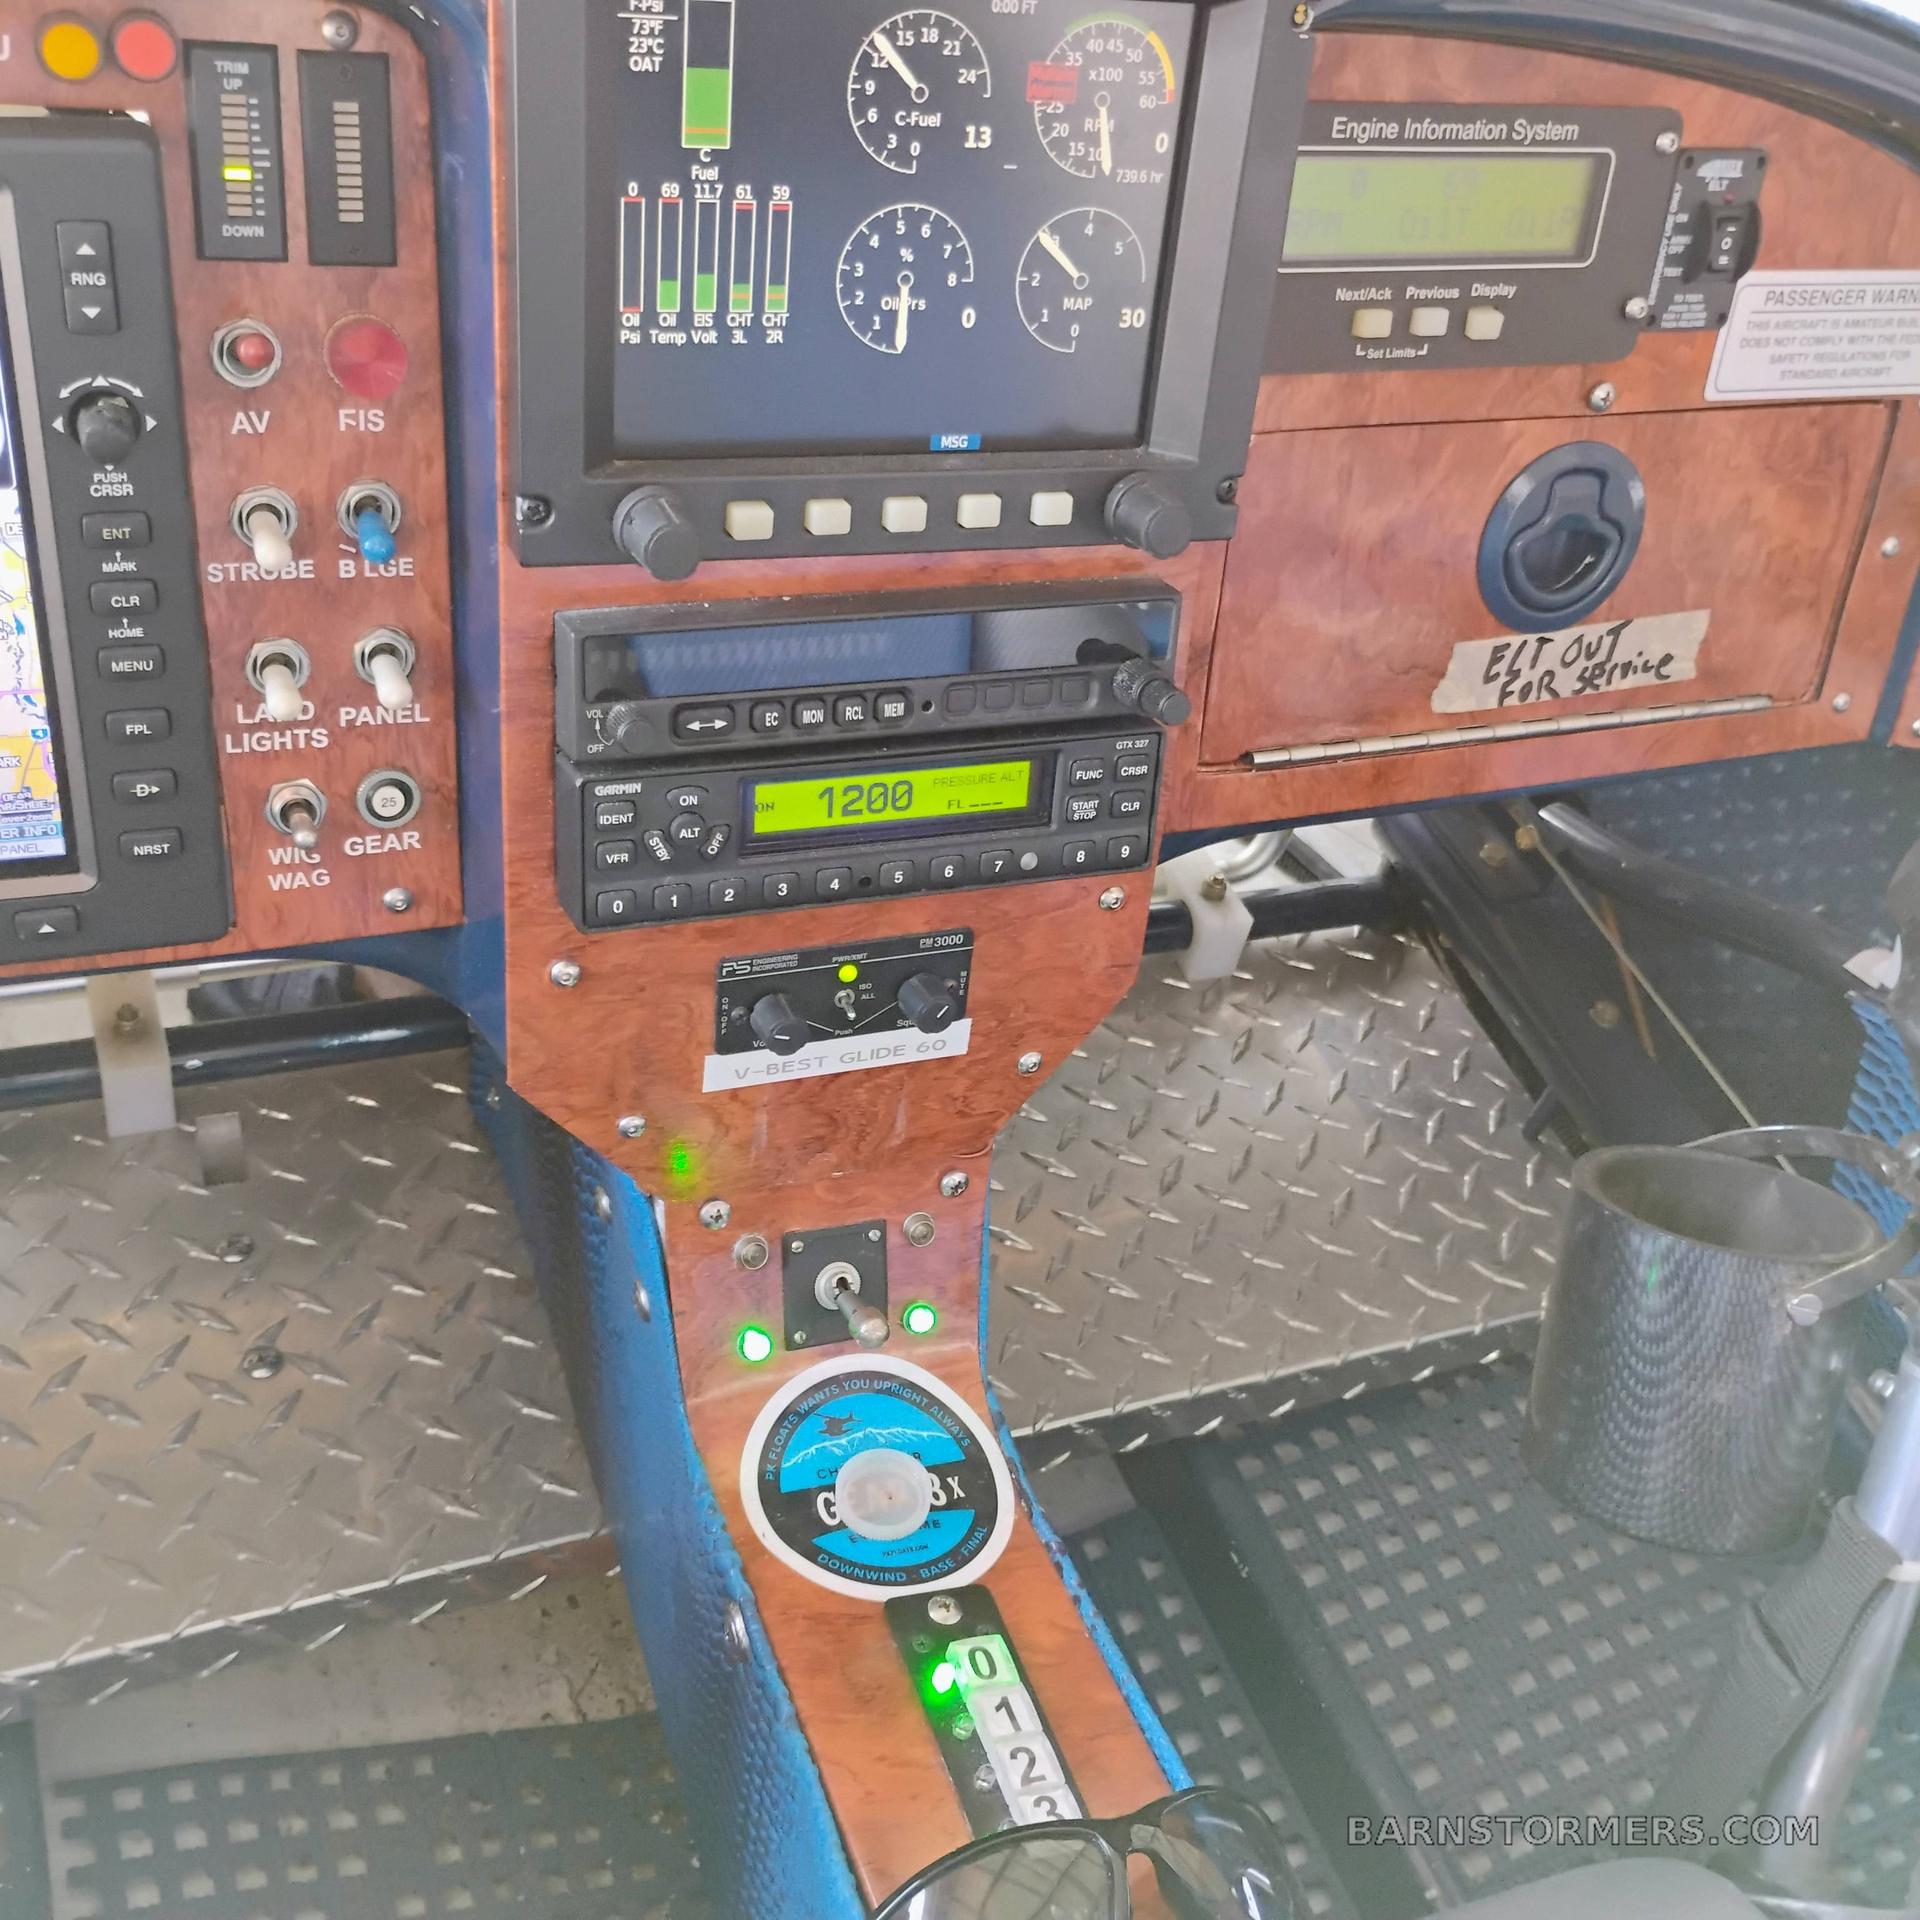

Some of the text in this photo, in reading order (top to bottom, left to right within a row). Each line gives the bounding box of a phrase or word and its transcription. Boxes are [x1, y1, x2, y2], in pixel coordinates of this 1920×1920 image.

[896, 31, 915, 46] 15
[920, 28, 939, 43] 18
[943, 41, 961, 56] 21
[1086, 39, 1104, 52] 40
[1106, 39, 1124, 53] 45
[1065, 52, 1082, 66] 35
[1126, 49, 1143, 63] 50
[214, 61, 249, 75] TRIM
[629, 56, 663, 72] OAT
[958, 69, 977, 84] 24
[1089, 68, 1123, 82] x100
[1139, 72, 1155, 85] 55
[223, 78, 242, 90] UP
[865, 80, 875, 95] 9
[867, 108, 878, 123] 6
[895, 111, 942, 127] C-Fuel
[964, 125, 992, 149] 13
[1051, 124, 1069, 137] 20
[1331, 117, 1579, 145] Engine Information System
[887, 134, 897, 149] 3
[1155, 132, 1169, 153] 0
[699, 148, 711, 162] C
[910, 142, 920, 156] 0
[1069, 142, 1085, 157] 15
[691, 165, 719, 181] Fuel
[1116, 170, 1147, 184] 739.6
[628, 182, 638, 197] 0
[661, 183, 680, 197] 69
[694, 184, 724, 199] 11.7
[735, 184, 753, 199] 61
[772, 185, 791, 200] 59
[222, 224, 265, 238] DOWN
[896, 220, 905, 235] 5
[921, 224, 931, 238] 6
[1084, 223, 1093, 236] 4
[869, 234, 879, 248] 4
[900, 248, 914, 262] %
[943, 244, 953, 259] 7
[1114, 242, 1123, 255] 5
[854, 263, 864, 277] 3
[71, 273, 106, 287] RNG
[947, 272, 957, 287] 8
[1031, 273, 1040, 287] 2
[854, 291, 864, 305] 2
[1335, 283, 1517, 302] Next/Ack Previous Display
[1764, 290, 1865, 306] PASSENGER
[1063, 297, 1093, 310] MAP
[622, 313, 640, 327] Oil
[659, 313, 677, 327] Oil
[694, 313, 714, 327] EIS
[726, 313, 754, 327] CHT
[762, 313, 789, 327] CHT
[872, 315, 880, 330] 1
[961, 307, 976, 329] 0
[1119, 309, 1145, 328] 30
[620, 331, 640, 344] Psi
[691, 331, 718, 344] Volt
[732, 331, 748, 344] 3L
[766, 331, 784, 344] 2R
[1070, 324, 1079, 337] 0
[649, 330, 687, 346] Temp
[1366, 347, 1416, 359] Set Limits
[231, 411, 270, 434] AV
[338, 408, 386, 433] FIS
[940, 435, 968, 449] MSG
[93, 472, 127, 484] PUSH
[90, 484, 134, 497] CRSR
[102, 527, 131, 541] ENT
[102, 560, 137, 573] MARK
[111, 595, 140, 608] CLR
[108, 627, 144, 639] HOME
[1483, 619, 1633, 684] ELT OUT
[111, 659, 153, 673] MENU
[1497, 670, 1560, 707] FOR
[237, 701, 315, 724] LAD
[339, 703, 430, 727] PANEL
[586, 709, 604, 719] VOL
[803, 709, 824, 724] MON
[845, 707, 864, 721] RCL
[884, 703, 905, 717] MEM
[765, 713, 778, 726] EC
[126, 724, 152, 736] FPL
[225, 728, 330, 754] LIGHTS
[1115, 739, 1149, 750] GTX 327
[587, 744, 605, 753] OFF
[1076, 769, 1103, 780] FUNC
[1120, 765, 1148, 777] CRSR
[933, 770, 1024, 788] PRESSURE ALT
[595, 783, 642, 796] GARMIN
[381, 796, 397, 809] 25
[679, 795, 698, 806] ON
[818, 780, 913, 818] 1200
[1072, 800, 1099, 810] START
[755, 803, 774, 814] ON
[1121, 802, 1140, 812] CLR
[600, 813, 634, 825] IDENT
[1073, 811, 1096, 821] STOP
[679, 828, 700, 839] ALT
[134, 843, 170, 856] NRST
[344, 831, 422, 856] GEAR
[649, 837, 671, 862] STBY
[708, 832, 725, 855] OFF
[268, 847, 321, 866] WIG
[606, 854, 628, 864] VFR
[1076, 850, 1086, 863] 8
[1121, 846, 1130, 858] 9
[944, 865, 954, 878] 6
[995, 860, 1003, 873] 7
[268, 868, 331, 891] WAG
[894, 871, 903, 883] 5
[778, 883, 788, 896] 3
[830, 879, 840, 890] 4
[671, 895, 678, 907] 1
[724, 889, 734, 902] 2
[613, 900, 623, 913] 0
[752, 954, 798, 966] ENGINEERING
[832, 953, 868, 963] PWR/XMT
[752, 961, 798, 972] INCORPORATED
[734, 1039, 947, 1080] V-BEST GLIDE 60
[765, 1378, 971, 1481] PK FLOATS WANTS YOU UPRIGHT ALWAYS
[817, 1553, 907, 1582] DOWNWIND
[920, 1559, 957, 1579] BASE
[962, 1526, 988, 1558] FINAL
[967, 1646, 998, 1680] 0
[994, 1696, 1022, 1732] 1
[1010, 1746, 1047, 1787] 2
